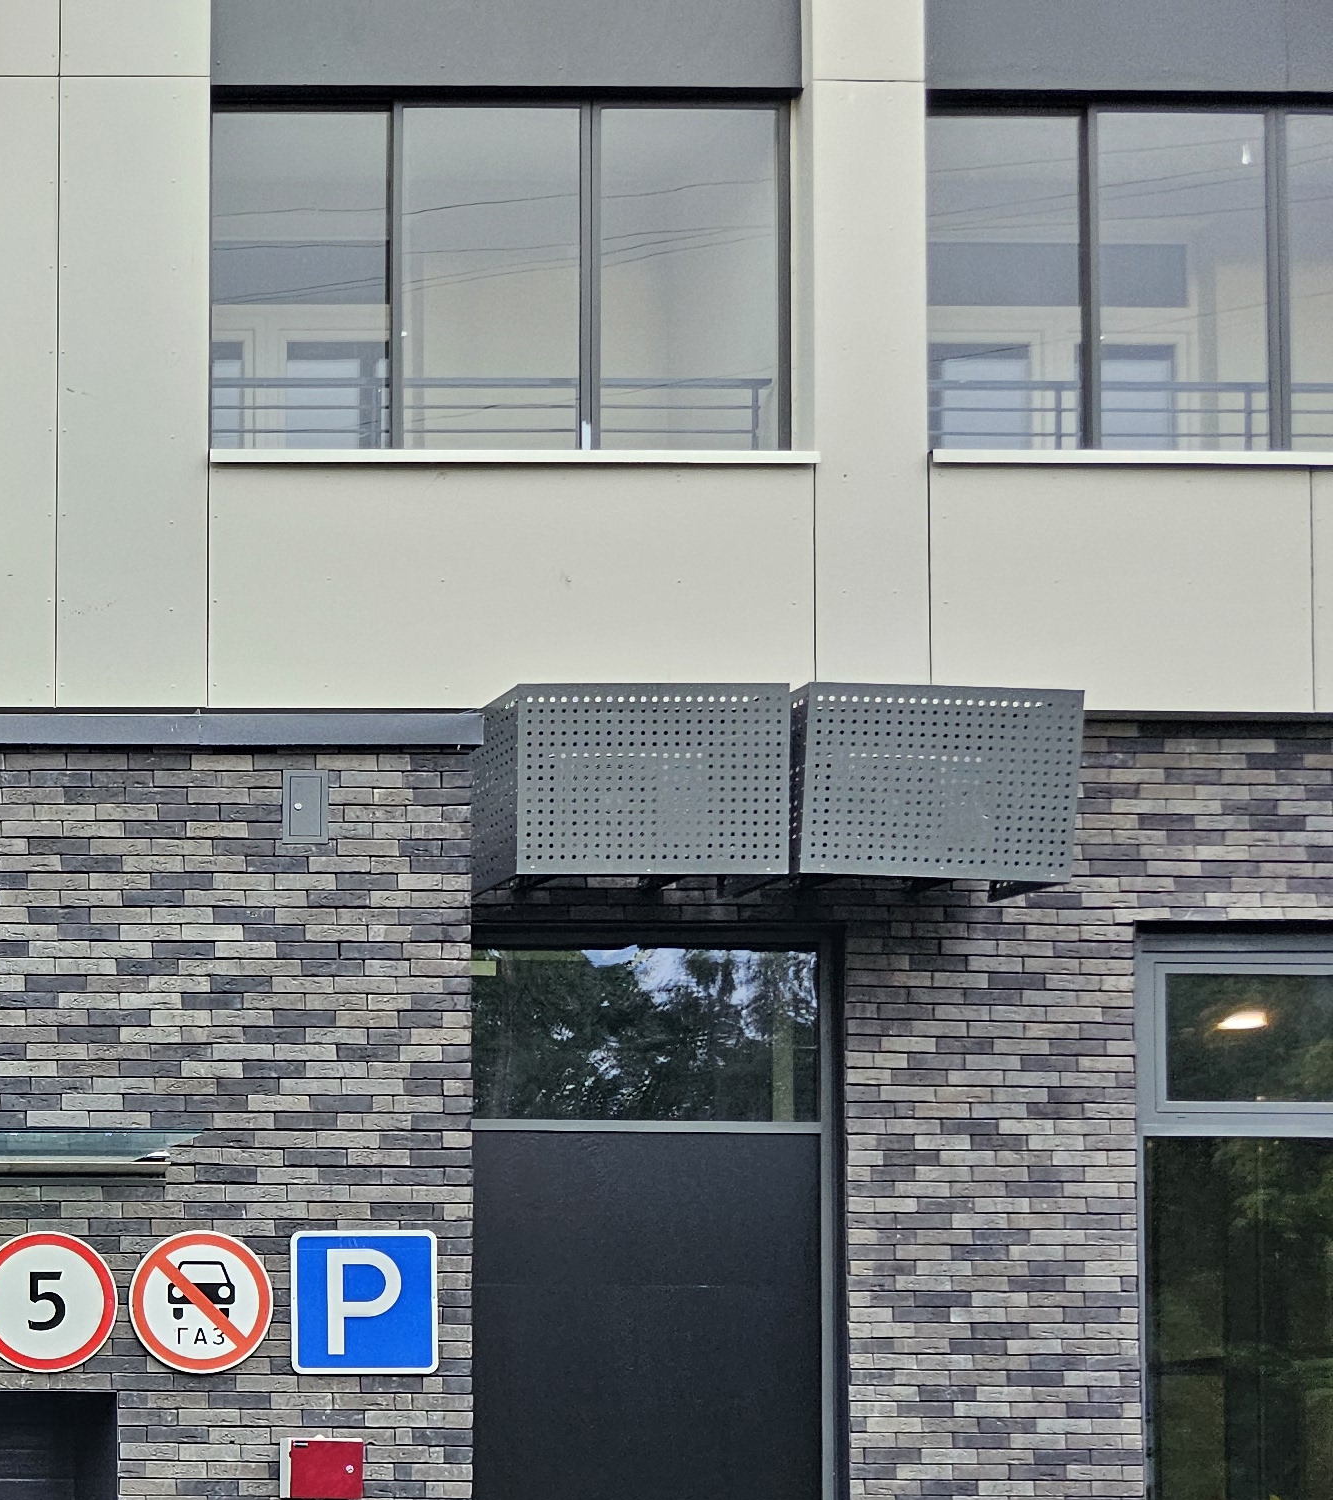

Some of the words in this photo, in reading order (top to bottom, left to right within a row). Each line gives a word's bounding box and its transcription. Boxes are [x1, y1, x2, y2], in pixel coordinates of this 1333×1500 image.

[27, 1271, 66, 1331] 5
[326, 1248, 402, 1355] P
[177, 1327, 226, 1345] ГАЗ
